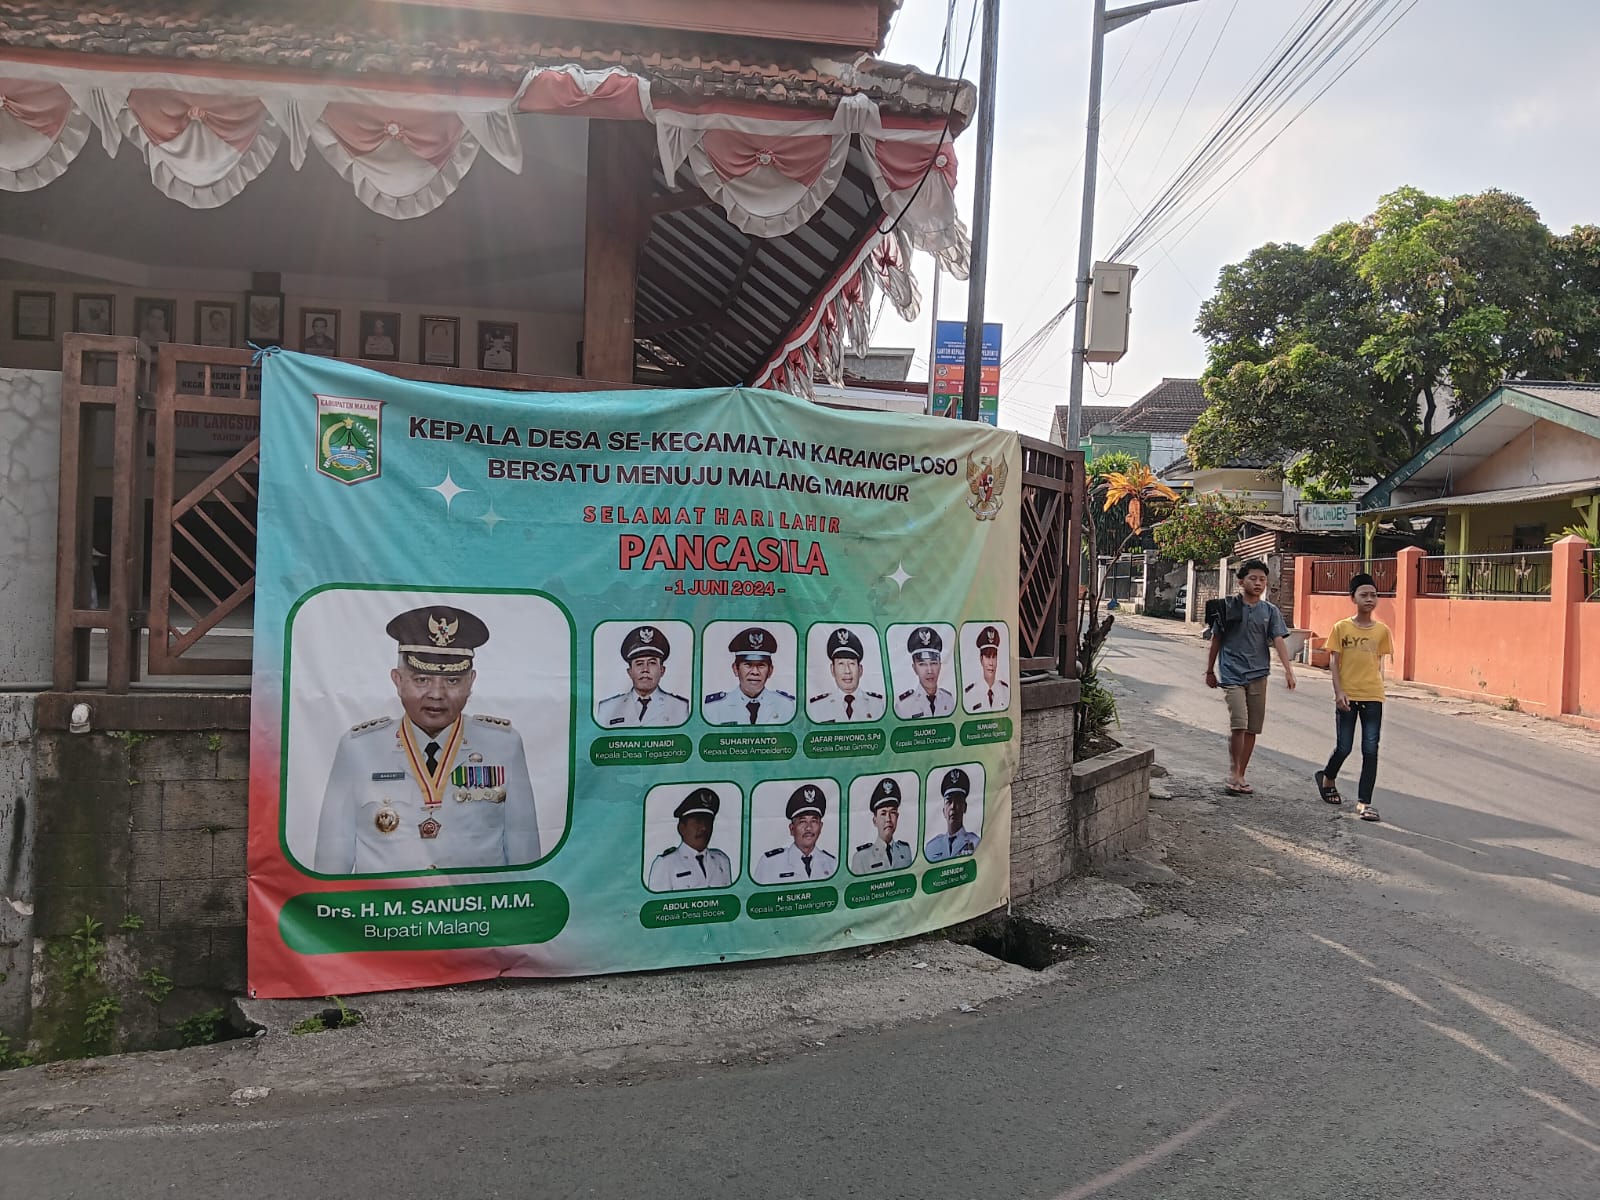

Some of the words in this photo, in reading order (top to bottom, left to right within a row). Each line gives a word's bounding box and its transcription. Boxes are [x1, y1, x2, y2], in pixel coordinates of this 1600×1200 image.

[320, 399, 354, 409] KABUPATEN
[354, 403, 379, 411] MALANG
[408, 415, 522, 447] KEPALA
[527, 427, 602, 450] DESA
[607, 431, 806, 459] SE-KECAMATAN
[810, 443, 958, 477] KARANGPLOSO
[487, 458, 610, 485] BERSATU
[616, 464, 723, 487] MENUJU
[727, 466, 821, 495] MALANG
[825, 477, 910, 502] MAKMUR
[583, 506, 706, 525] SELAMAT
[714, 508, 774, 528] HARI
[779, 513, 841, 534] LAHIR
[619, 534, 829, 576] PANCASILA
[688, 579, 729, 596] JUNI
[913, 728, 937, 737] SUJOKO
[608, 740, 641, 749] USMAN
[642, 739, 675, 749] JUNAIDI
[719, 737, 778, 746] SUHARIYANTO
[810, 735, 834, 744] JAFAR
[895, 739, 913, 748] Kepala
[913, 738, 926, 746] Desa
[703, 746, 728, 756] Kepala
[729, 747, 749, 755] Desa
[812, 744, 835, 753] Kepala
[835, 744, 851, 752] Desa
[595, 751, 621, 760] Kepala
[622, 751, 643, 759] Desa
[787, 892, 812, 902] SUKAR
[851, 894, 870, 904] Kepala
[871, 891, 885, 900] Desa
[316, 903, 356, 919] Drs.
[360, 902, 380, 918] H.
[384, 901, 407, 917] M.
[411, 896, 487, 915] SANUSI,
[491, 893, 535, 910] M.M.
[662, 902, 690, 912] ABDUL
[691, 899, 719, 909] KODIM
[750, 904, 774, 914] Kepala
[775, 903, 793, 912] Desa
[655, 912, 681, 922] Kepala
[682, 911, 701, 919] Desa
[364, 920, 423, 940] Bupati
[427, 918, 490, 937] Malang
